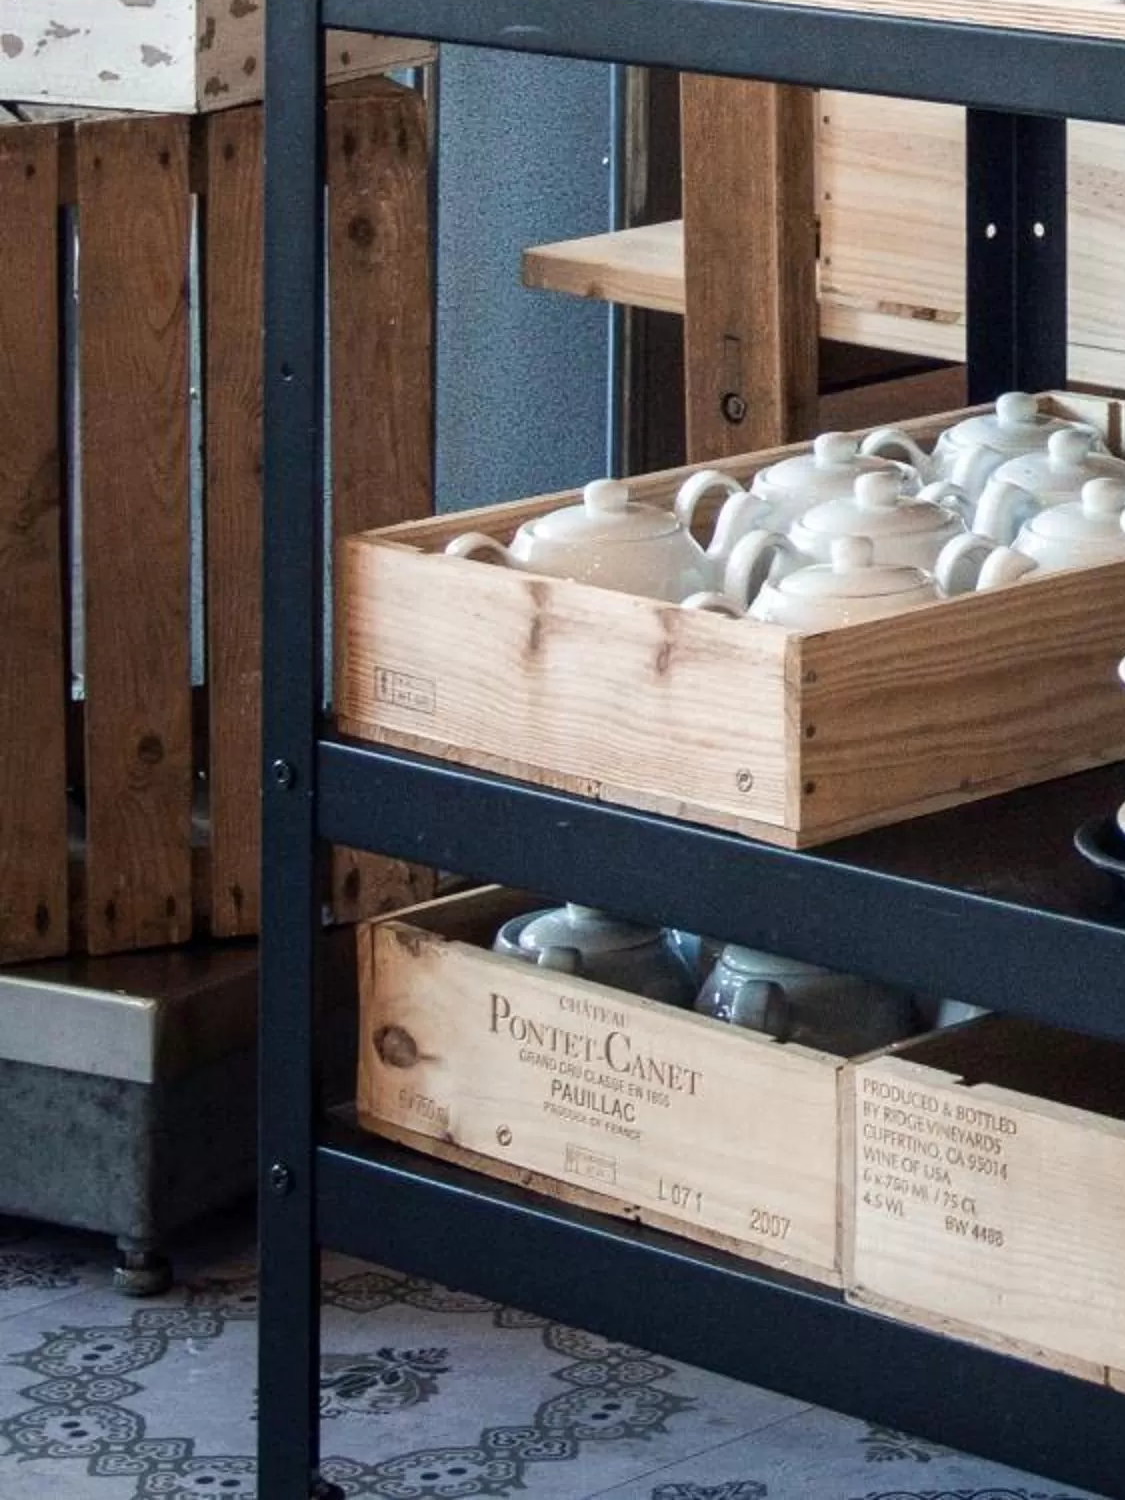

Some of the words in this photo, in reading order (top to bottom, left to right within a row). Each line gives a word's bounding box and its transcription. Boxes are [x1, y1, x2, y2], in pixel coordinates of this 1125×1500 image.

[550, 1077, 636, 1124] PAUILLAC
[863, 1077, 939, 1113] PRODUCED
[943, 1101, 952, 1117] &
[956, 1104, 1018, 1135] BOTTLED
[863, 1101, 881, 1118] BY
[863, 1146, 900, 1170] WINE
[901, 1157, 921, 1177] OF
[923, 1163, 951, 1185] USA
[946, 1147, 965, 1167] CA
[750, 1208, 792, 1240] 2007
